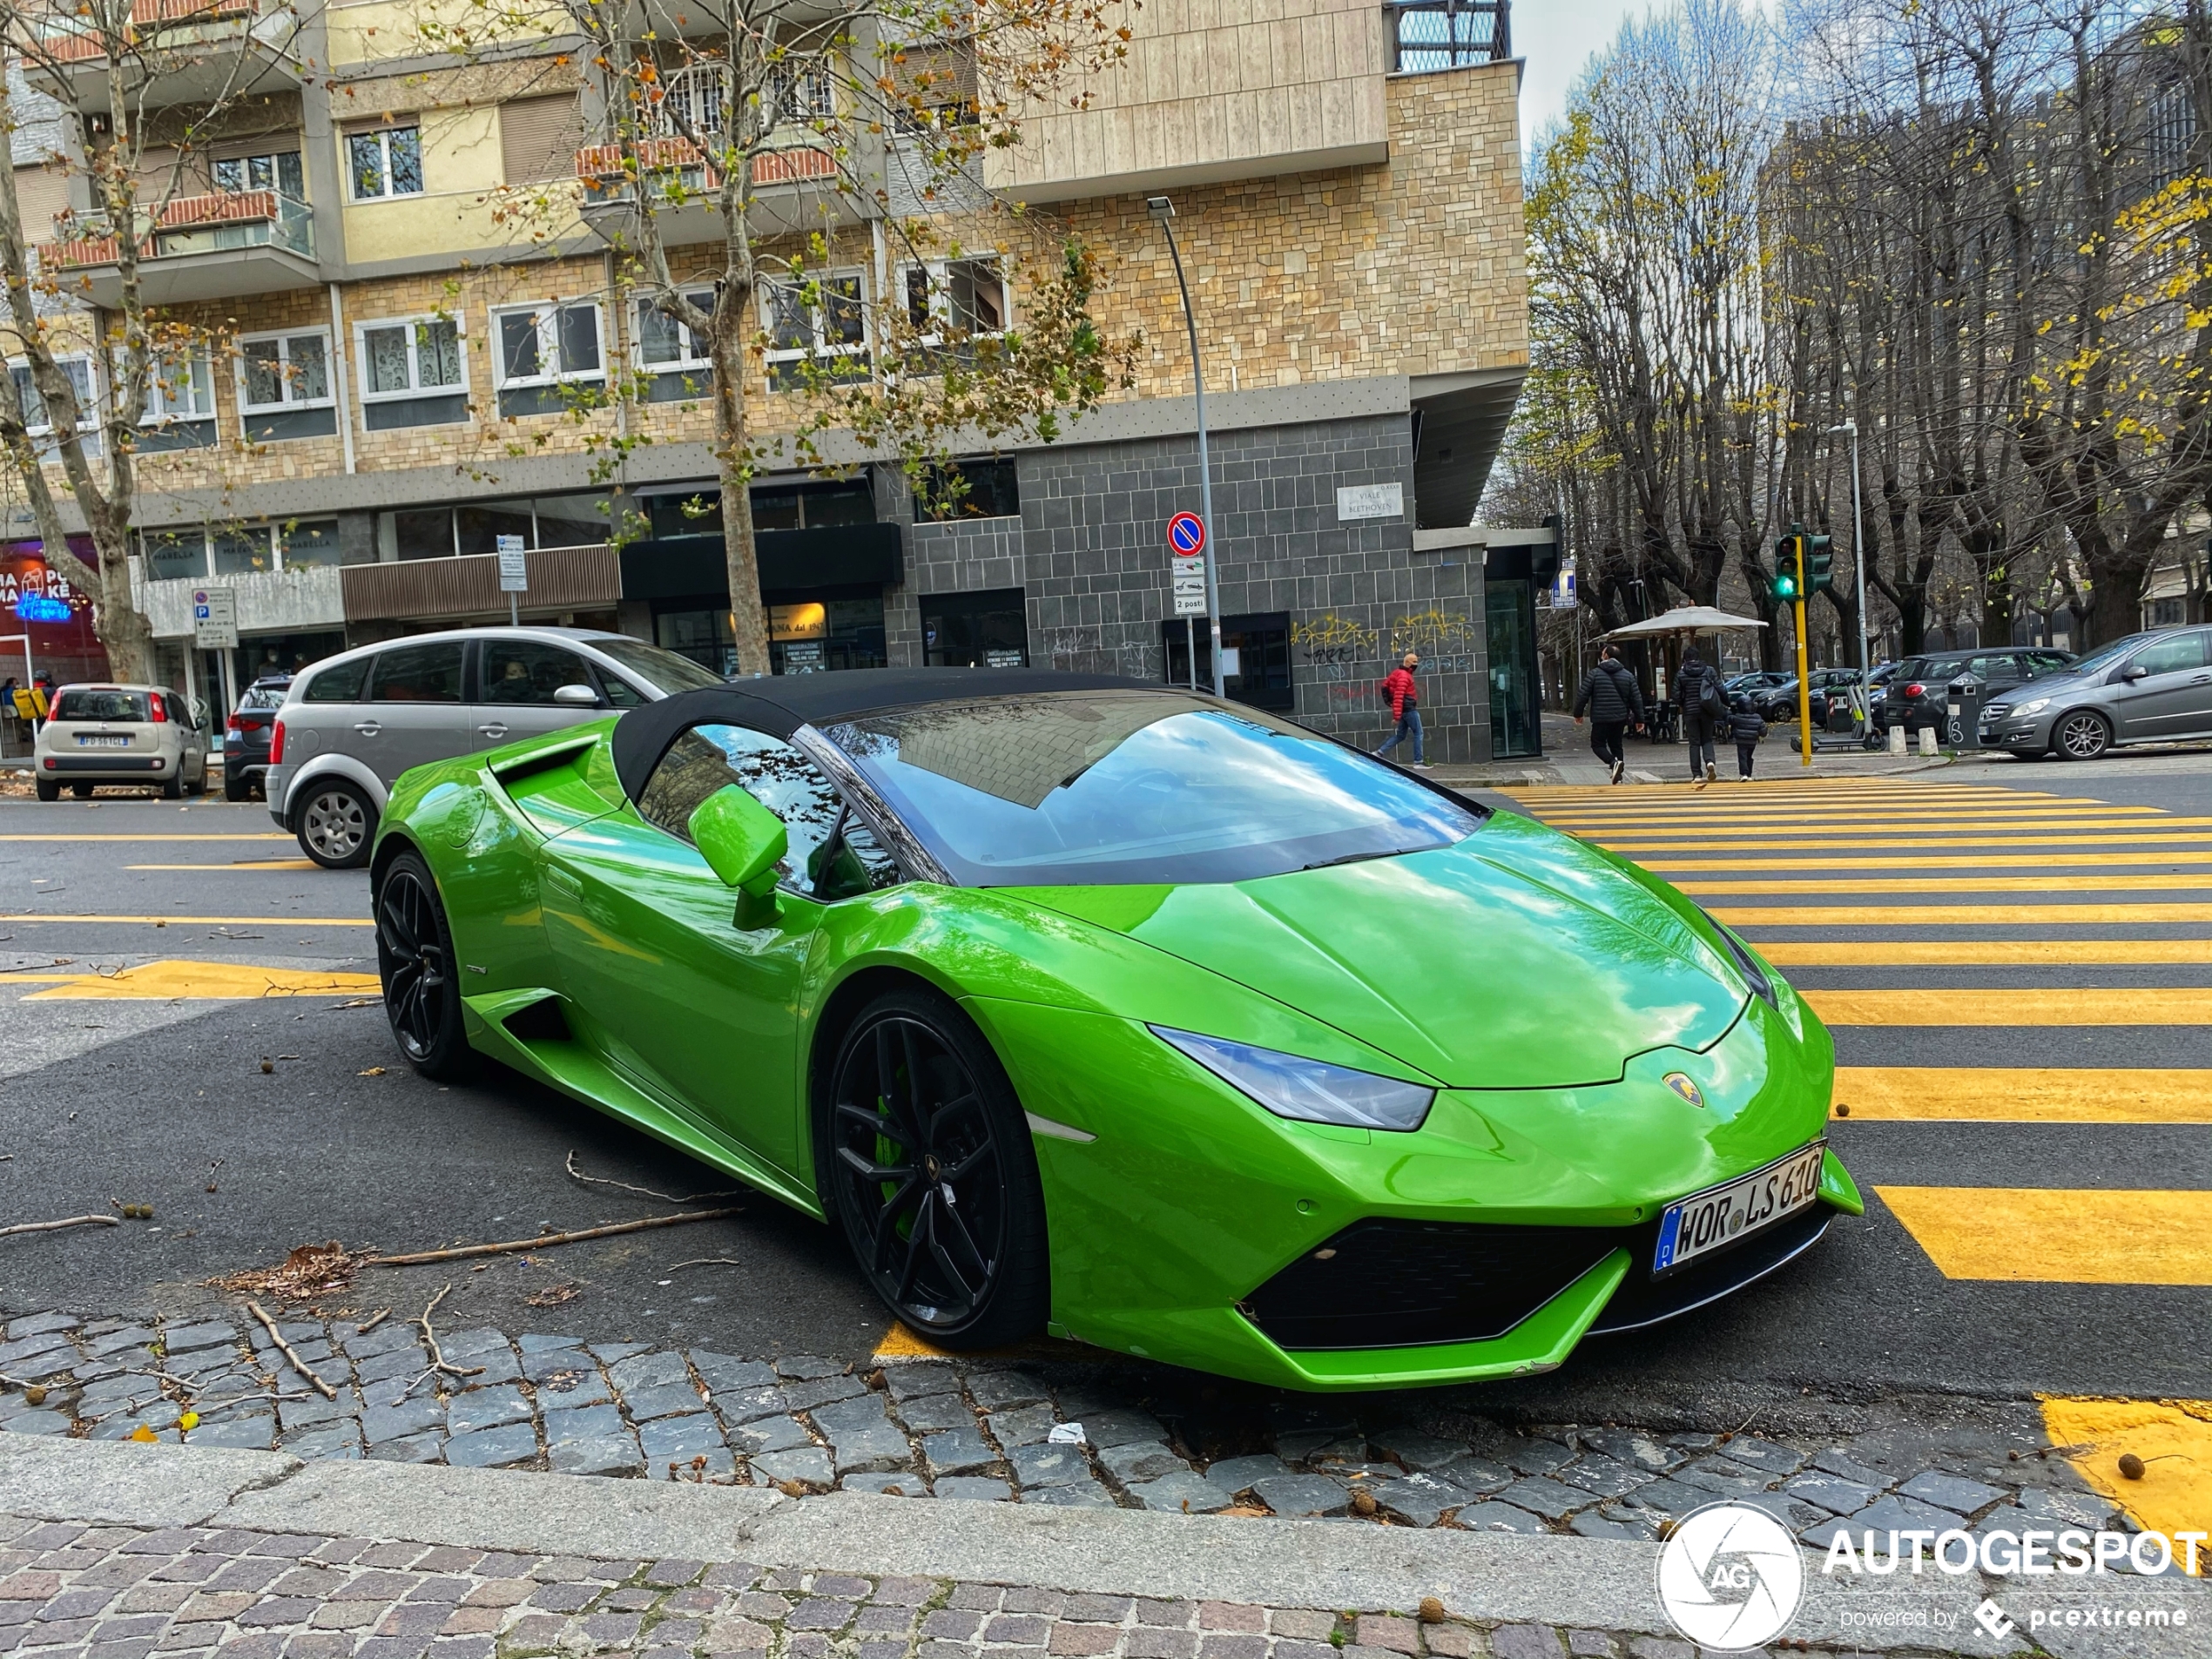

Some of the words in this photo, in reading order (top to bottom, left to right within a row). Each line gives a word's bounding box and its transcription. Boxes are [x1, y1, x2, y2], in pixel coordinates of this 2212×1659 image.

[1349, 503, 1392, 513] BEETHOVEN
[290, 539, 331, 550] MARELLA
[154, 550, 194, 560] MARELLA
[809, 623, 824, 631] 1947
[1662, 1245, 1669, 1258] D
[1677, 1196, 1732, 1256] WOR
[1744, 1175, 1779, 1227] LS
[1780, 1154, 1819, 1209] 610
